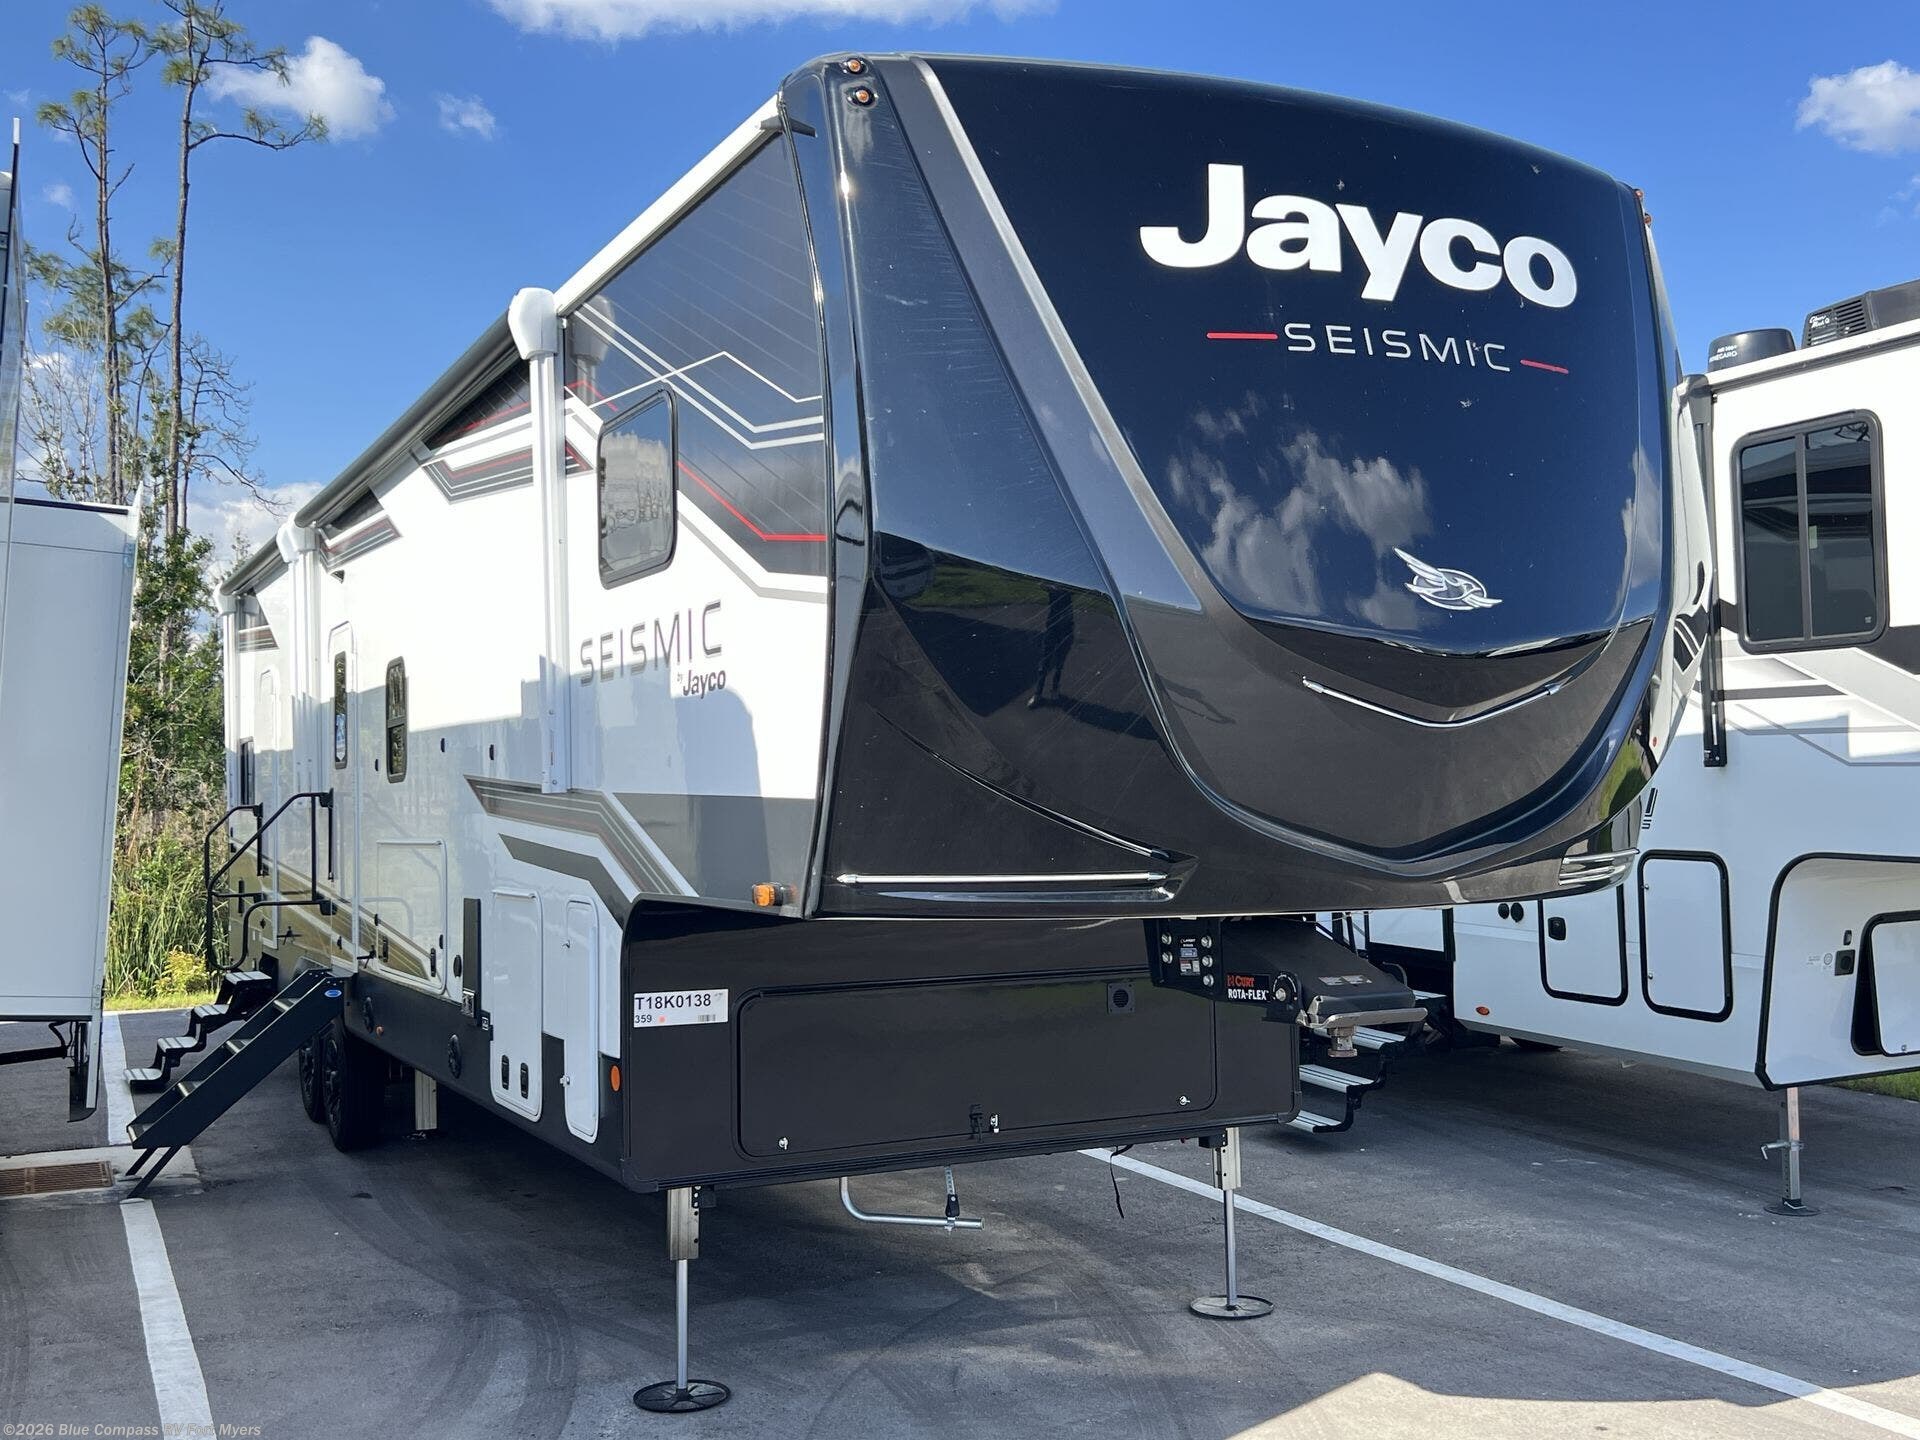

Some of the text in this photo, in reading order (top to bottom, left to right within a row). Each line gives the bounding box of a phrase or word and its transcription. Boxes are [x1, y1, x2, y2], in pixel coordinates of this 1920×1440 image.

[1139, 163, 1578, 308] Jayco
[1284, 323, 1511, 372] SEISMIC
[580, 599, 722, 687] SEISMIC
[683, 670, 726, 699] Jayco
[634, 993, 712, 1010] T18K0138
[634, 1014, 652, 1023] 359
